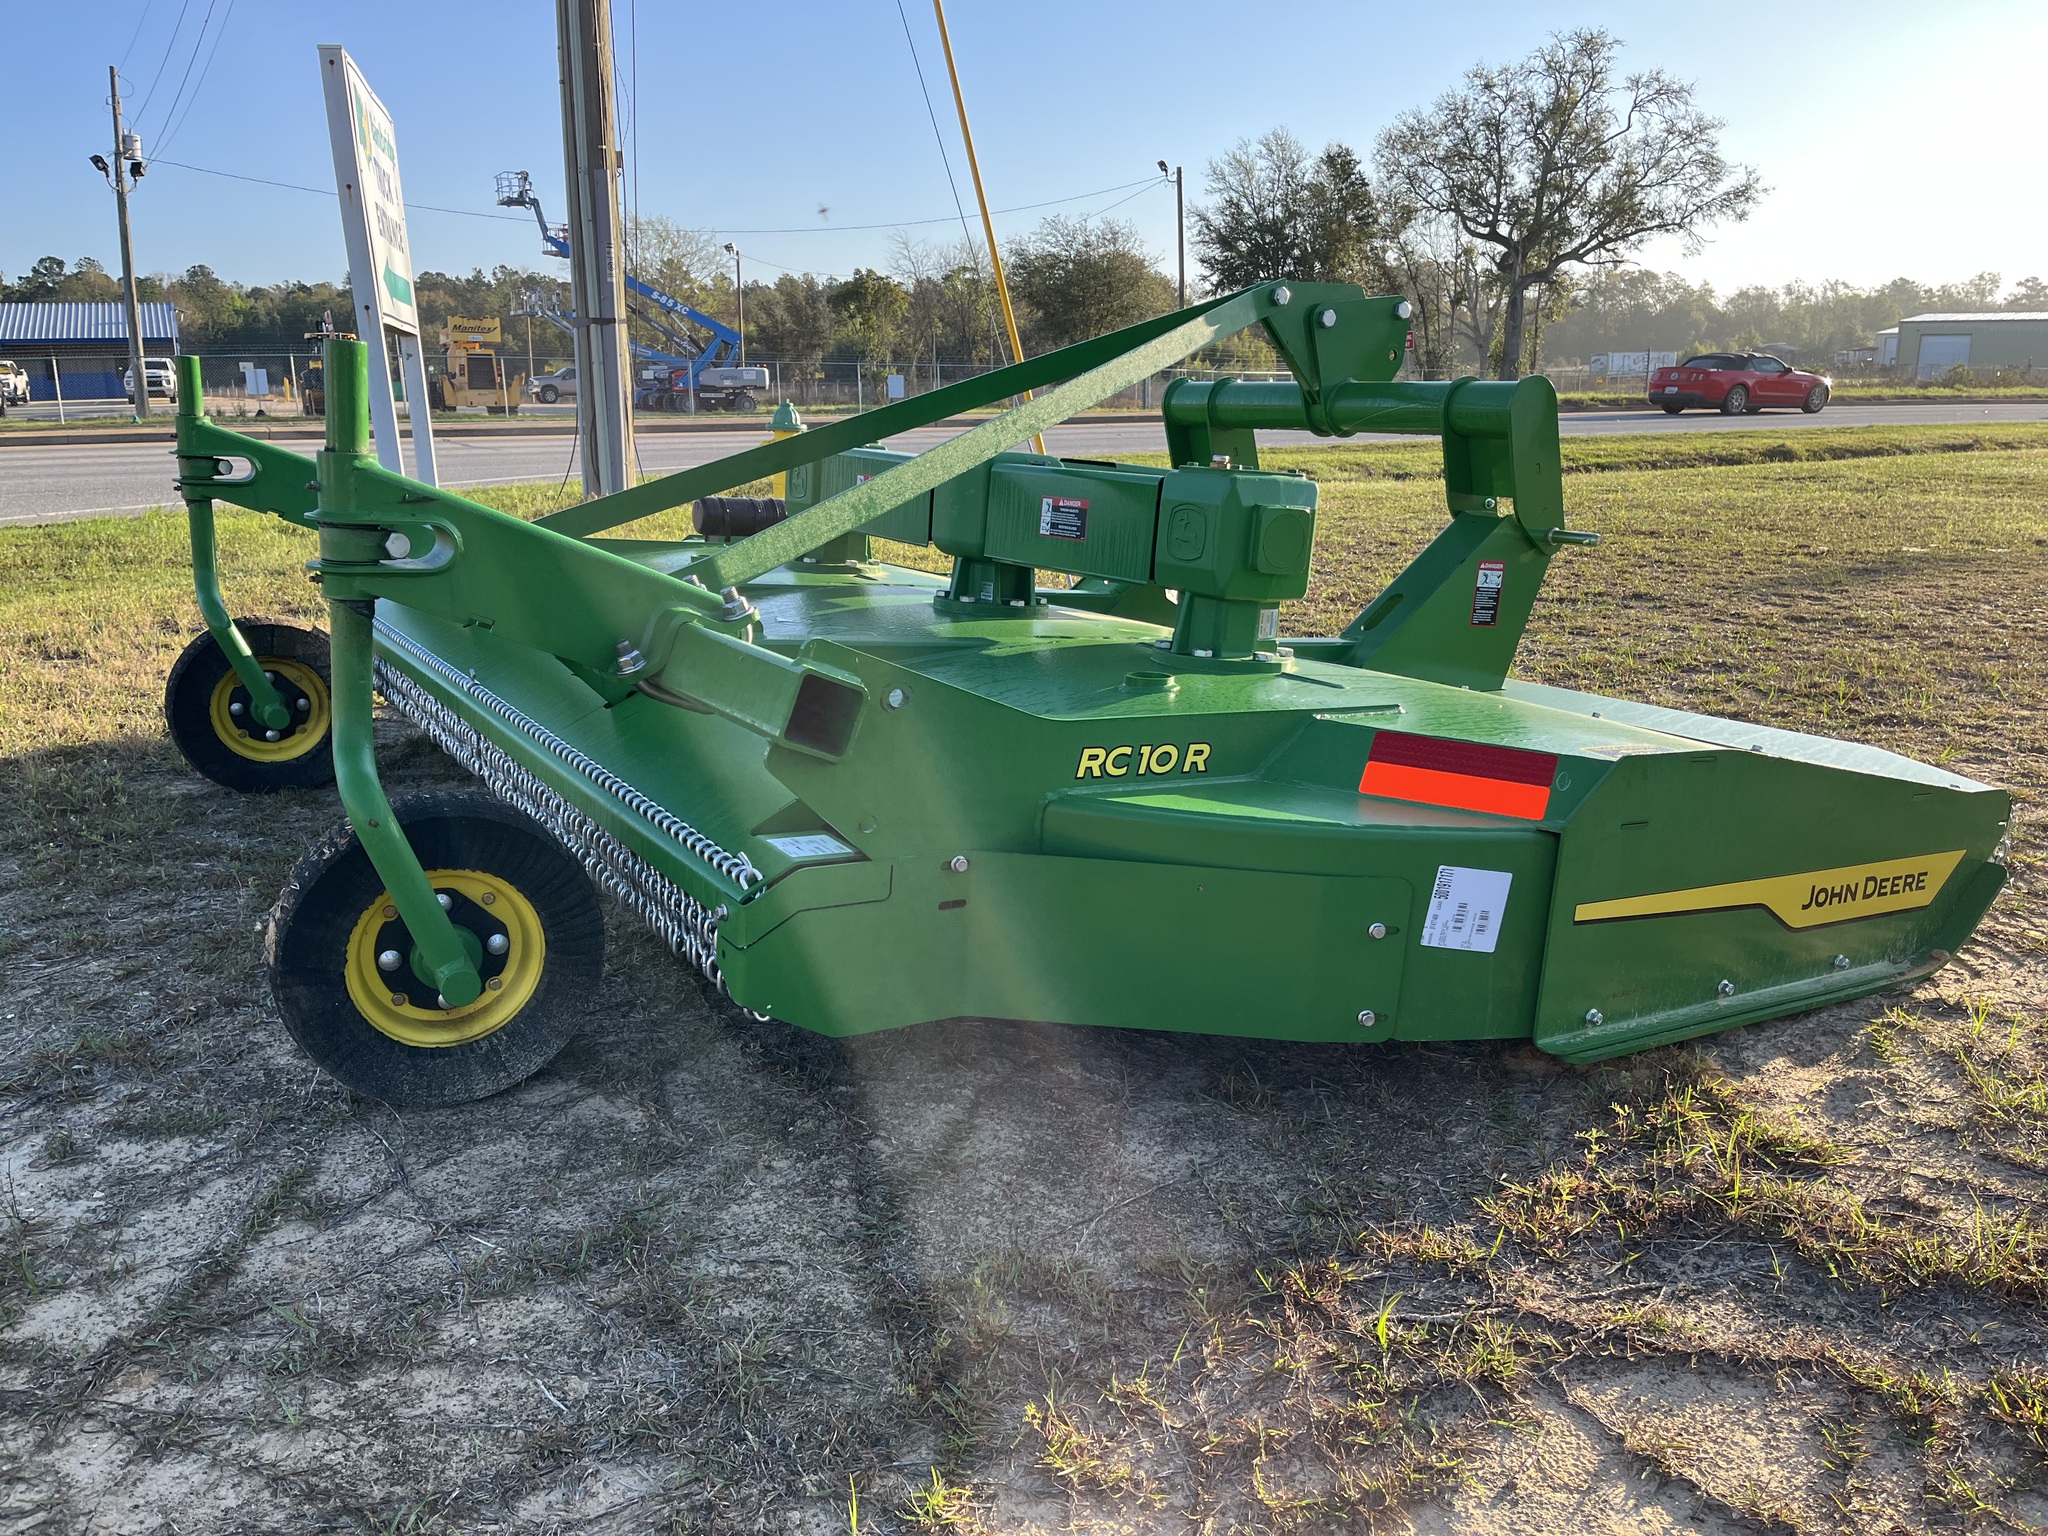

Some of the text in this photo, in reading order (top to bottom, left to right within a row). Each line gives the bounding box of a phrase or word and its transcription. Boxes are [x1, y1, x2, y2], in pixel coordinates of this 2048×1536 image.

[373, 156, 394, 206] TRUCK
[375, 201, 404, 255] ENTRANCE
[651, 291, 690, 315] S-85 XC
[452, 324, 492, 333] Manitex
[1063, 499, 1082, 507] DANGER
[1075, 742, 1212, 780] RC 10 R
[1801, 871, 1929, 911] JOHN DEERE
